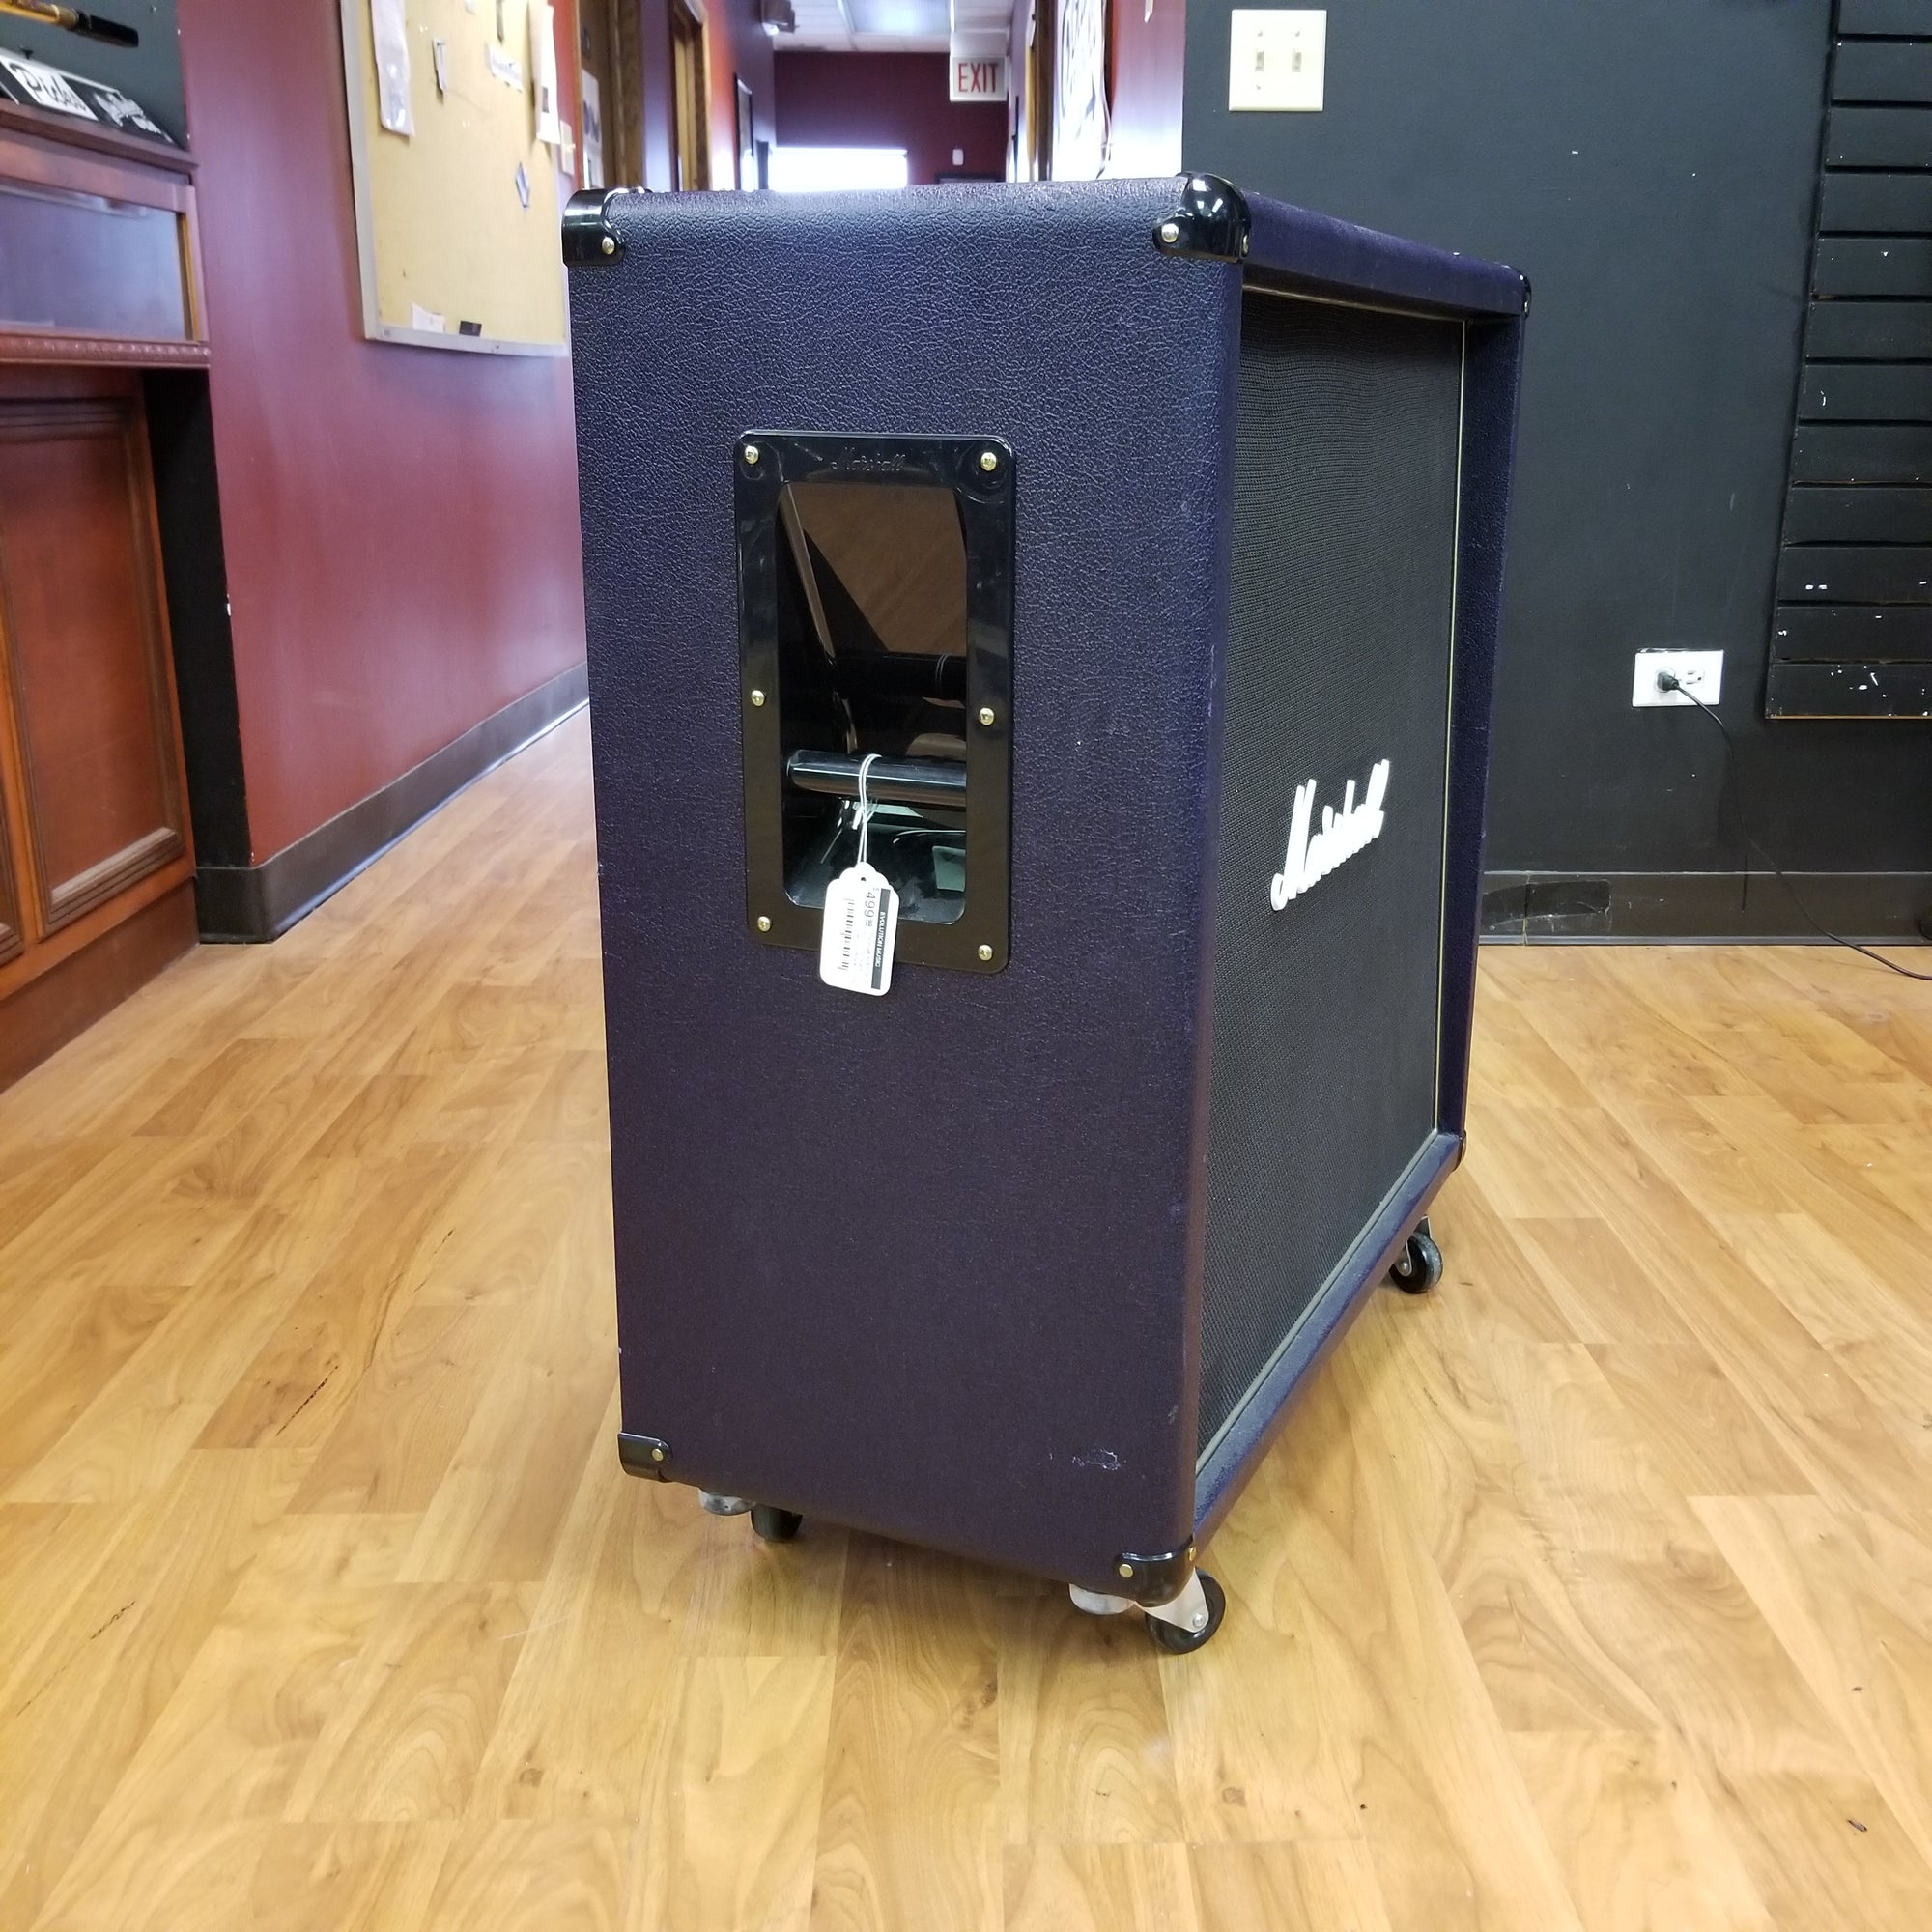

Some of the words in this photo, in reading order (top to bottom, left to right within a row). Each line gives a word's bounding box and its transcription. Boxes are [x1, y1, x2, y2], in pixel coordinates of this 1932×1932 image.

[958, 62, 999, 93] EXIT
[876, 911, 886, 947] EVOLUTION
[874, 947, 883, 968] MUSIC
